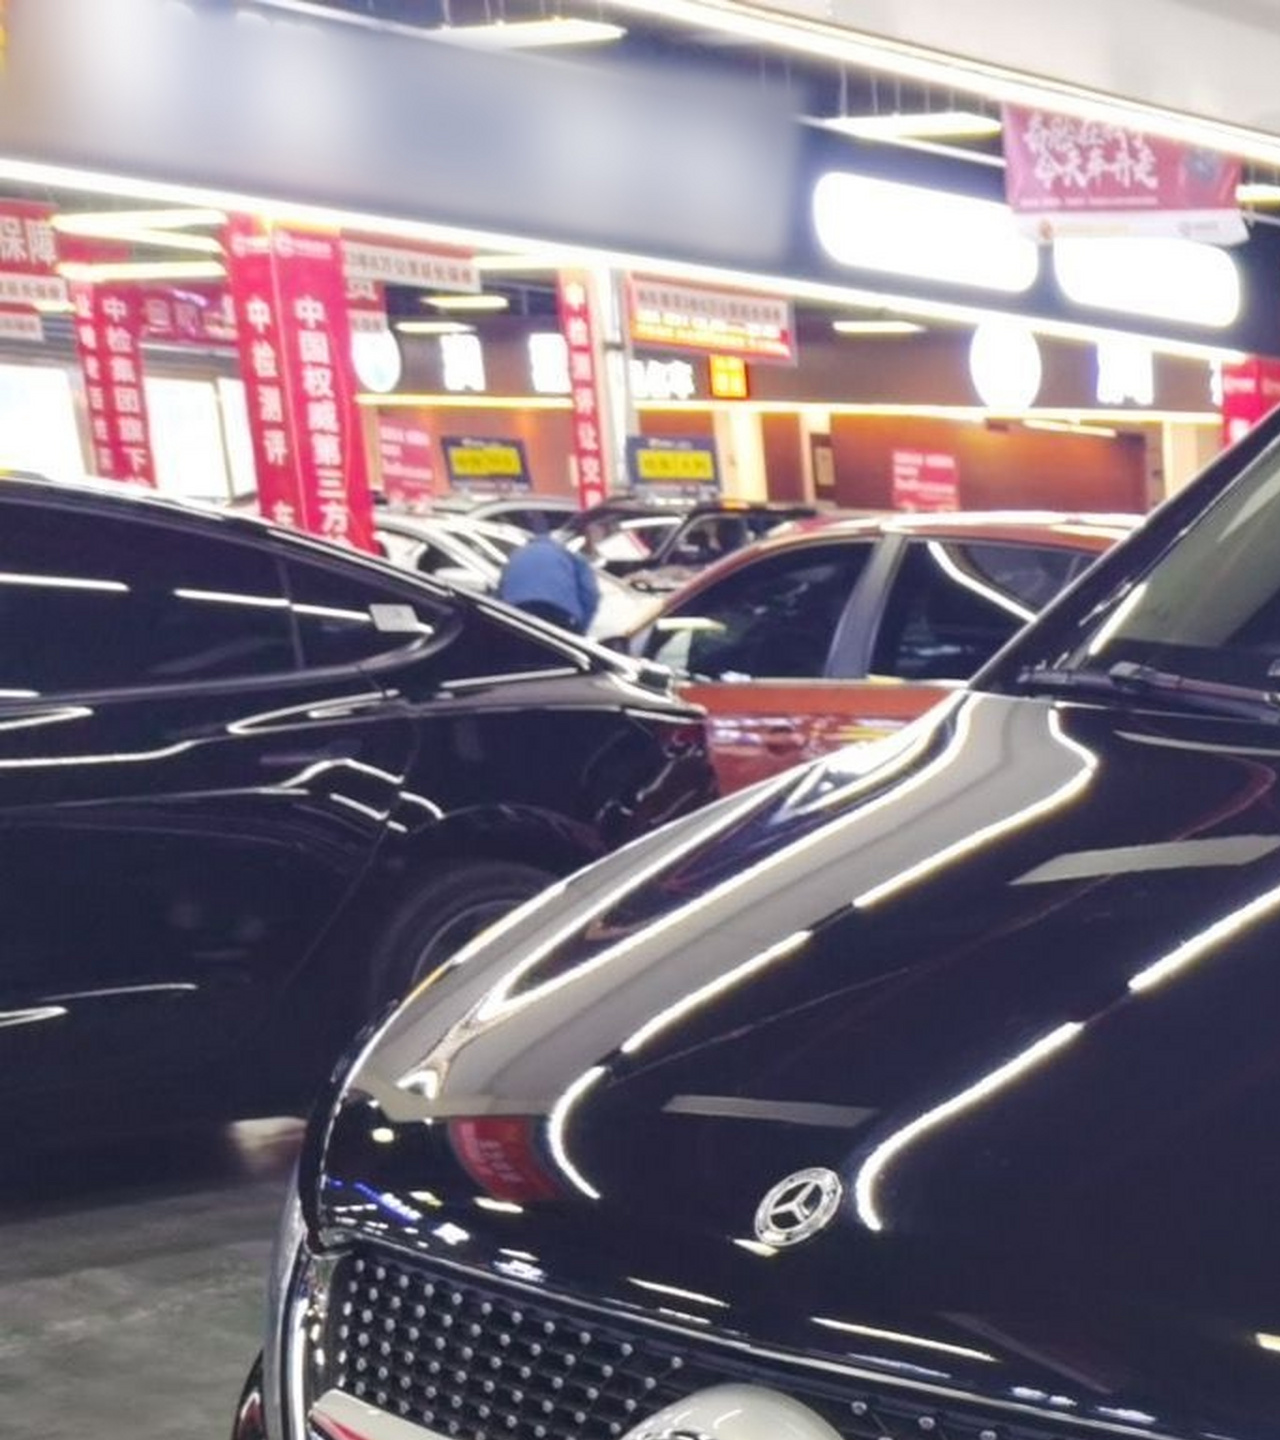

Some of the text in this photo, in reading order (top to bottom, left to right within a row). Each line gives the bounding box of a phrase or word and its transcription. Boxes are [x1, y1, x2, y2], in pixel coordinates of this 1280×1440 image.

[101, 295, 150, 482] 中检集团旗下
[294, 294, 350, 540] 中国权威第三方
